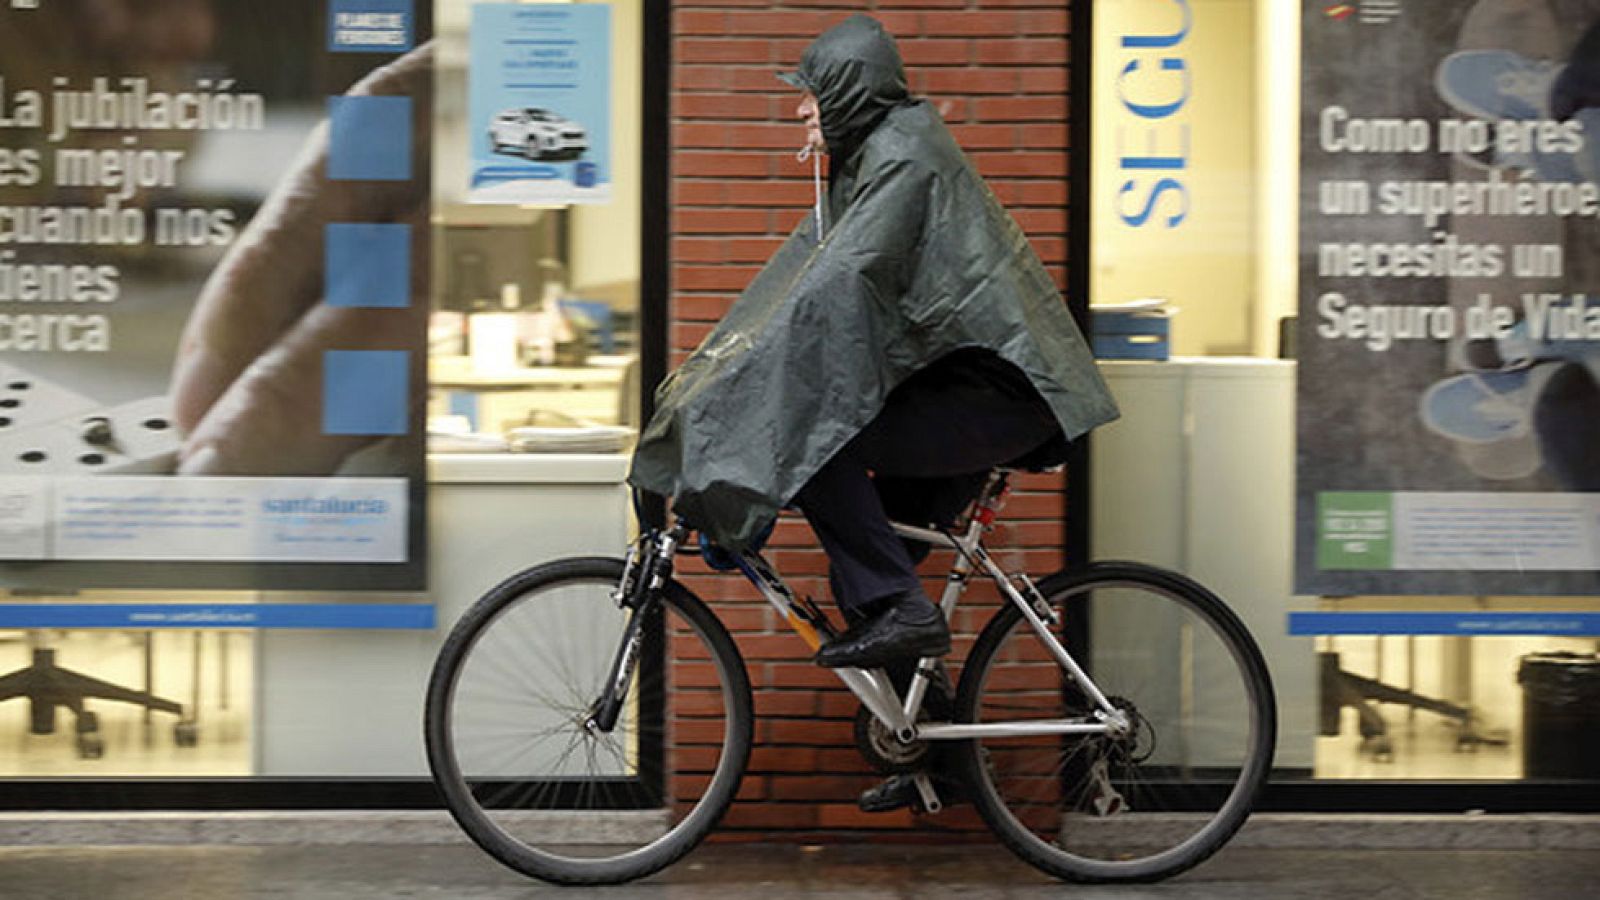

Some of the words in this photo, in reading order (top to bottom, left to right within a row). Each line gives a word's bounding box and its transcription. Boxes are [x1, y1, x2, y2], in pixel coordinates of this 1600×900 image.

[48, 77, 265, 142] jubilación
[1319, 105, 1430, 153] Como
[1438, 118, 1488, 153] no
[1501, 119, 1584, 154] eres
[55, 136, 184, 200] mejor
[0, 195, 146, 244] cuando
[154, 208, 236, 245] nos
[1319, 179, 1369, 215] un
[0, 250, 121, 302] ienes
[1318, 231, 1504, 277] necesitas
[1512, 244, 1563, 277] un
[0, 314, 110, 351] cerca
[1317, 291, 1455, 351] Seguro
[1464, 293, 1514, 338] de
[1521, 293, 1600, 339] Vida
